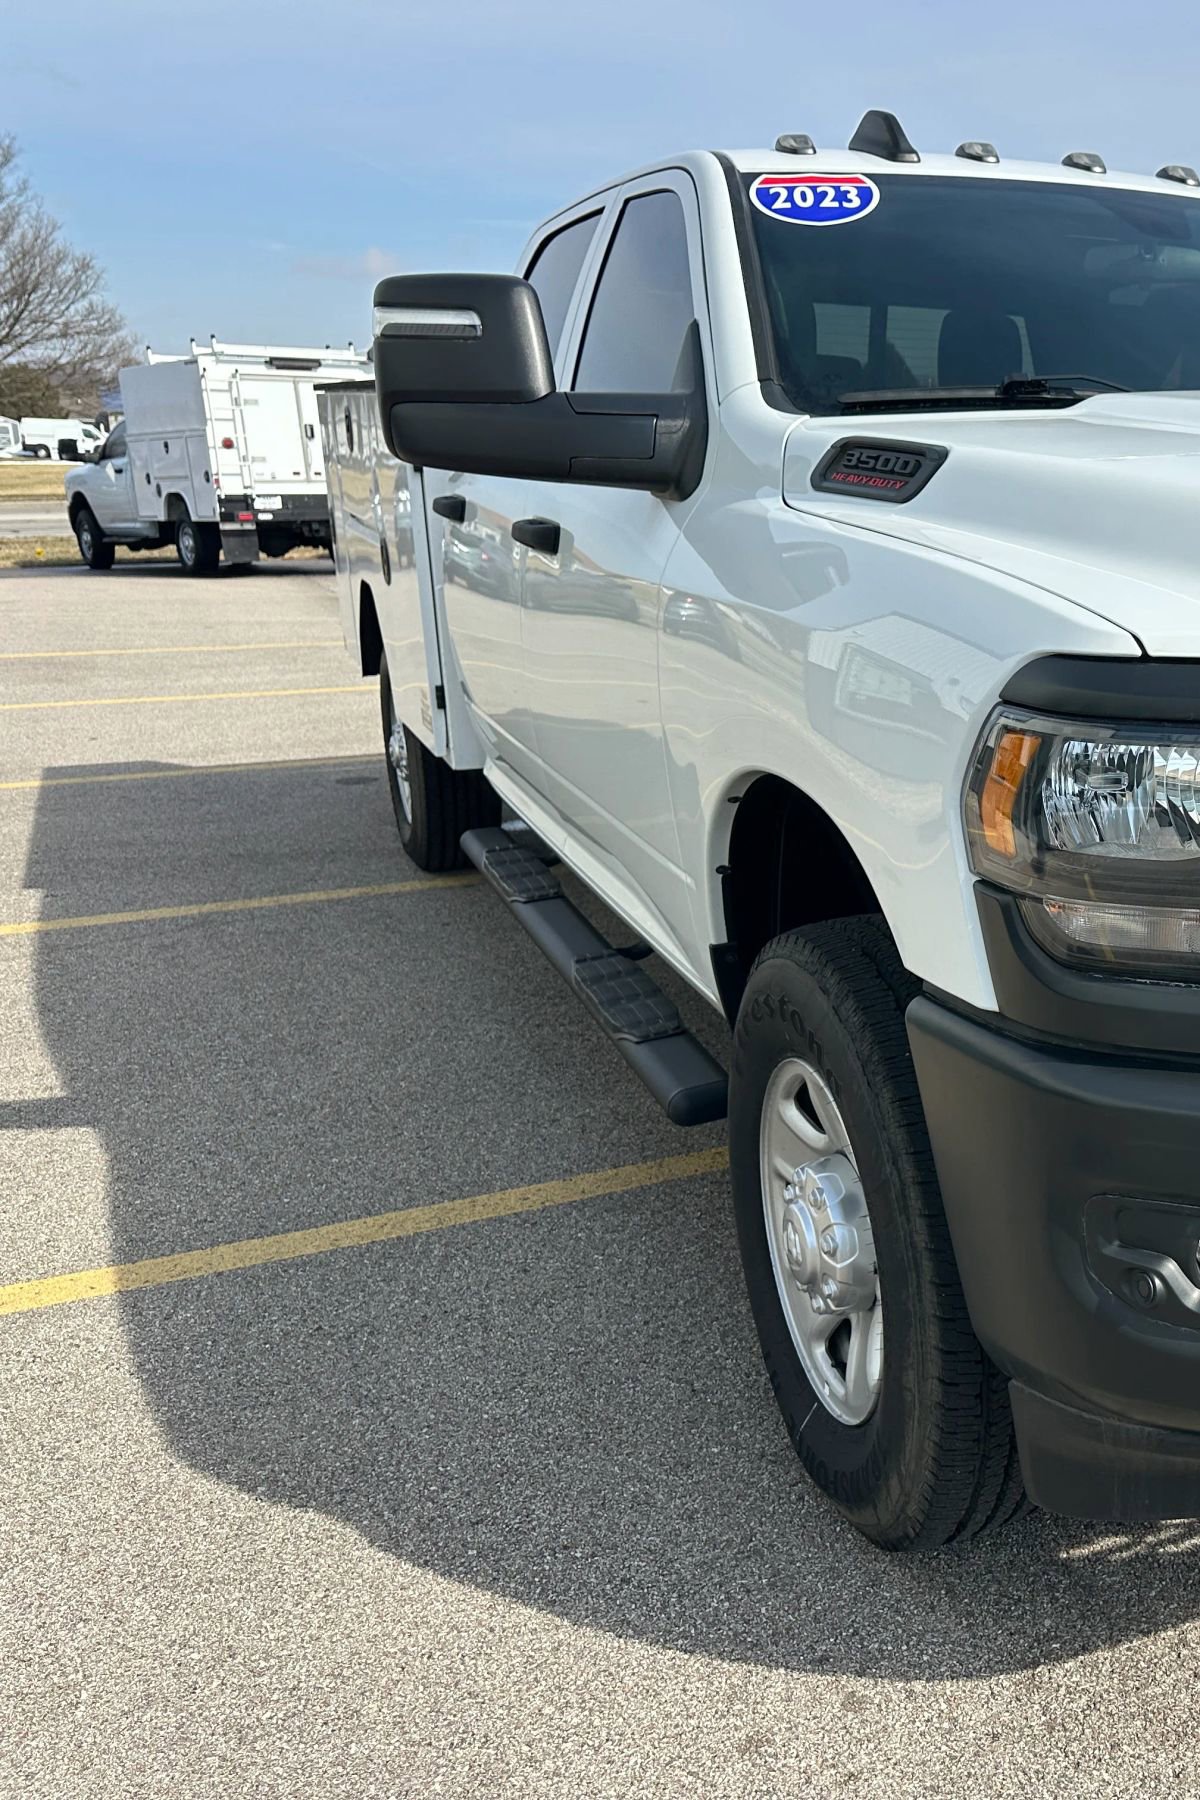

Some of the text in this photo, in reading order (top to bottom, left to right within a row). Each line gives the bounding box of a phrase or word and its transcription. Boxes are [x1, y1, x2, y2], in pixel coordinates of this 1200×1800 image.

[769, 186, 862, 209] 2023
[841, 450, 918, 475] 3500
[831, 472, 908, 490] HEAVY DUTY
